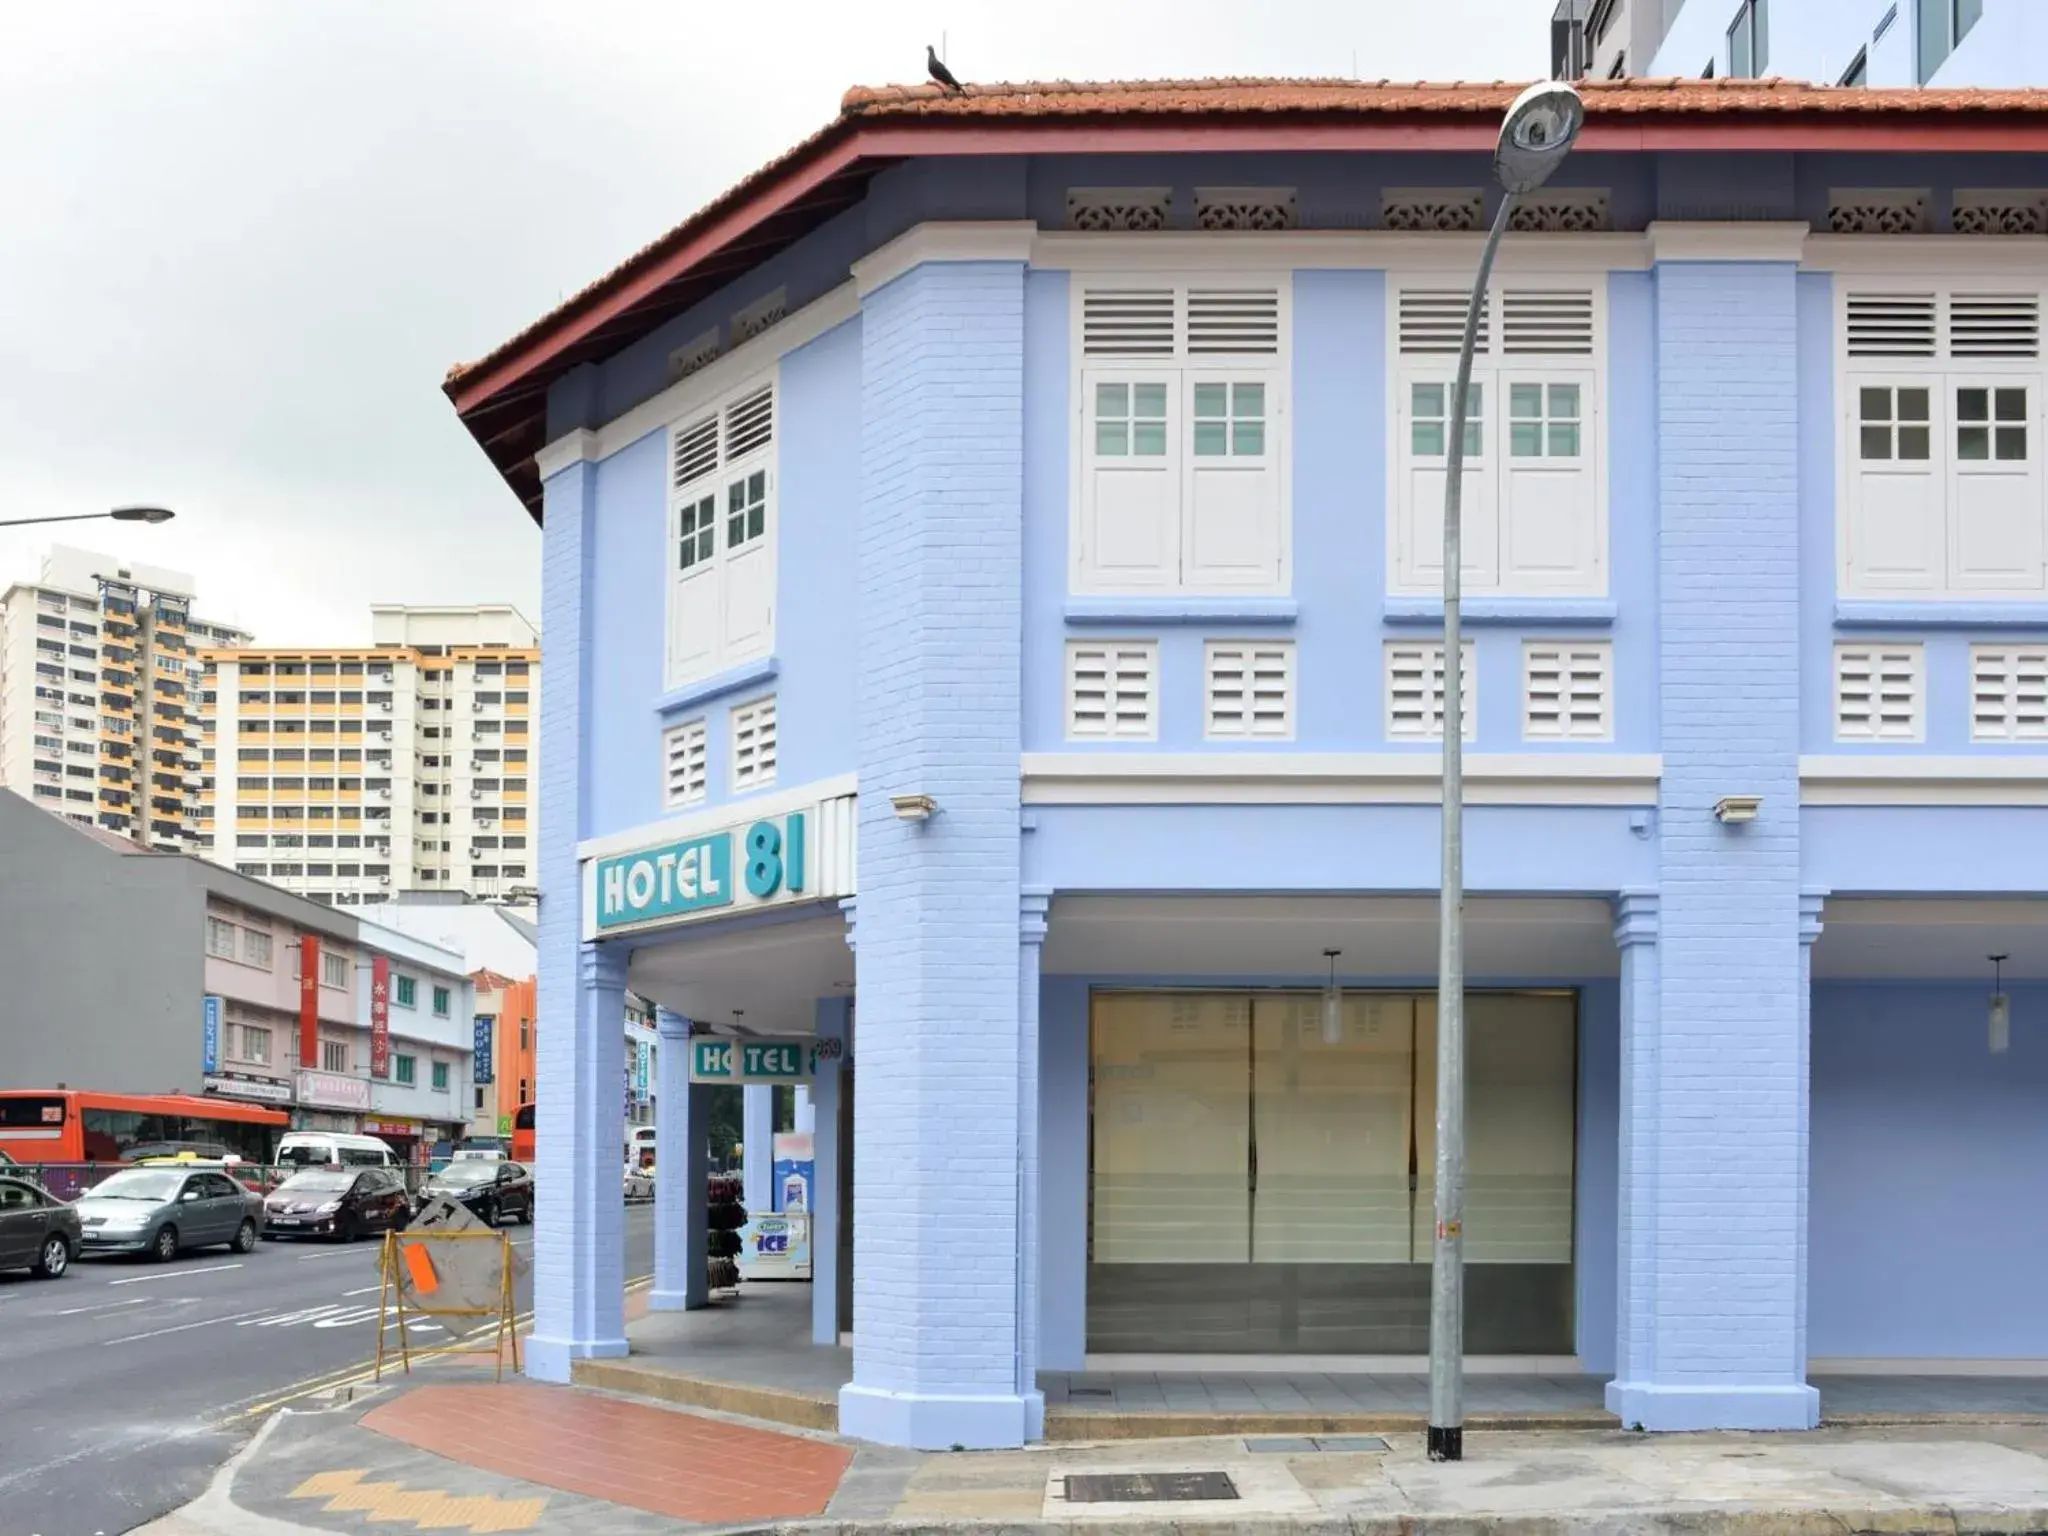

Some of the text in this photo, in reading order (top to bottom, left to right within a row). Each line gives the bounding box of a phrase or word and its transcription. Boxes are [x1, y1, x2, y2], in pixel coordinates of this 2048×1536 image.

[604, 812, 805, 915] HOTEL 81
[703, 1047, 794, 1072] HOTEL
[757, 1235, 788, 1251] ICE
